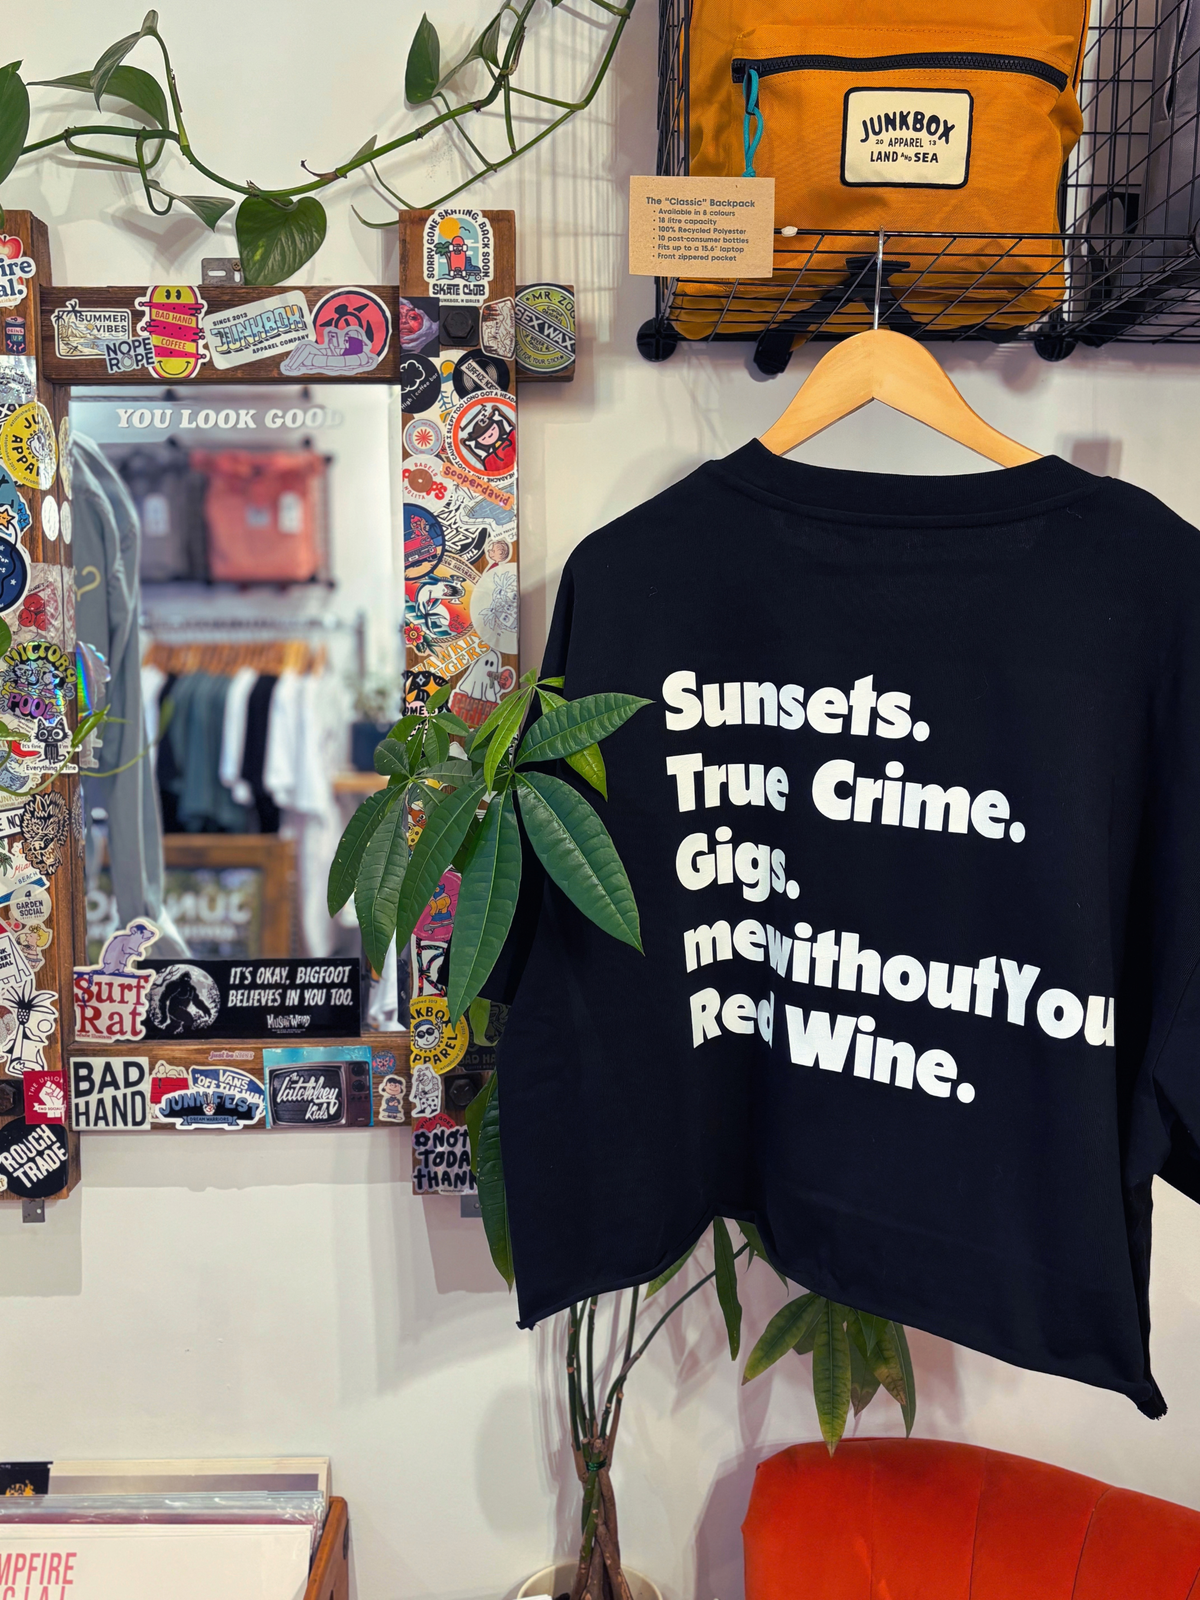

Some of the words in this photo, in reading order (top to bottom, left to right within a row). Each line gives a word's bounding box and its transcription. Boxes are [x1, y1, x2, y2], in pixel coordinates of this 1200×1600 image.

[860, 110, 955, 145] JUNKBOX
[888, 137, 924, 148] APPAREL
[870, 151, 898, 162] LAND
[900, 152, 912, 162] AND
[914, 152, 939, 163] SEA
[646, 196, 662, 205] The
[710, 199, 755, 208] Backpack
[658, 208, 692, 216] Available
[427, 217, 441, 245] GONE
[678, 226, 711, 235] Recycled
[713, 228, 746, 236] Polyester
[684, 218, 717, 226] capacity
[478, 221, 491, 249] BACK
[667, 236, 721, 244] post-consumer
[678, 253, 709, 262] zippered
[719, 246, 744, 254] laptop
[427, 247, 435, 279] SORRY
[481, 251, 490, 280] SOON.
[432, 283, 460, 296] SKATE
[462, 283, 486, 296] CLUB
[78, 314, 127, 323] SUMMER
[154, 310, 170, 321] BAD
[171, 314, 193, 326] HAND
[532, 291, 556, 302] MR.
[557, 295, 575, 326] ZOG
[95, 324, 127, 333] VIBES
[210, 305, 308, 354] JUNKBOX
[212, 316, 232, 327] SINCE
[232, 312, 248, 323] 2013
[515, 306, 543, 331] SEX
[543, 323, 576, 351] WAX
[105, 337, 153, 358] NOPE
[160, 337, 187, 350] COFFEE
[252, 342, 279, 354] APPAREL
[279, 333, 310, 347] COMPANY
[108, 351, 156, 373] ROPE
[401, 397, 413, 411] High
[413, 380, 430, 398] coffee
[428, 372, 439, 384] bar
[116, 408, 173, 429] YOU
[178, 408, 257, 429] LOOK
[264, 408, 343, 429] GOOD
[446, 416, 456, 434] SLEPT
[454, 403, 464, 415] TOO
[464, 392, 480, 405] LONG
[414, 462, 438, 477] BAGELS
[404, 485, 426, 500] NOLITA
[443, 466, 511, 507] Sooperdavid
[4, 641, 77, 684] VICTORY
[8, 692, 55, 719] POOL
[662, 670, 930, 742] Sunsets.
[26, 764, 58, 773] Everything
[666, 752, 790, 812] True
[812, 759, 1026, 843] Crime.
[676, 826, 800, 902] Gigs.
[18, 871, 39, 885] BEACH
[16, 900, 44, 910] GARDEN
[19, 907, 45, 917] SOCIAL
[230, 967, 251, 984] IT'S
[256, 966, 290, 985] OKAY,
[296, 965, 352, 984] BIGFOOT
[683, 918, 1115, 1047] mewithoutYou
[74, 976, 150, 1006] Surf
[228, 989, 282, 1007] BELIEVES
[285, 989, 300, 1006] IN
[304, 989, 327, 1006] YOU
[330, 988, 354, 1006] TOO.
[77, 1004, 143, 1037] Rat
[411, 1033, 459, 1065] PPAREL
[689, 987, 776, 1050] Red
[785, 1004, 976, 1104] Wine.
[73, 1061, 145, 1099] BAD
[219, 1070, 250, 1090] VANS
[290, 1072, 300, 1081] The
[28, 1083, 38, 1096] THE
[276, 1073, 339, 1115] Latchkey
[75, 1090, 147, 1127] HAND
[305, 1101, 329, 1121] Kids
[419, 1116, 436, 1129] WHAT
[438, 1116, 454, 1129] GOES
[0, 1123, 57, 1173] ROUGH
[13, 1142, 69, 1188] TRADE
[418, 1149, 471, 1170] TODA
